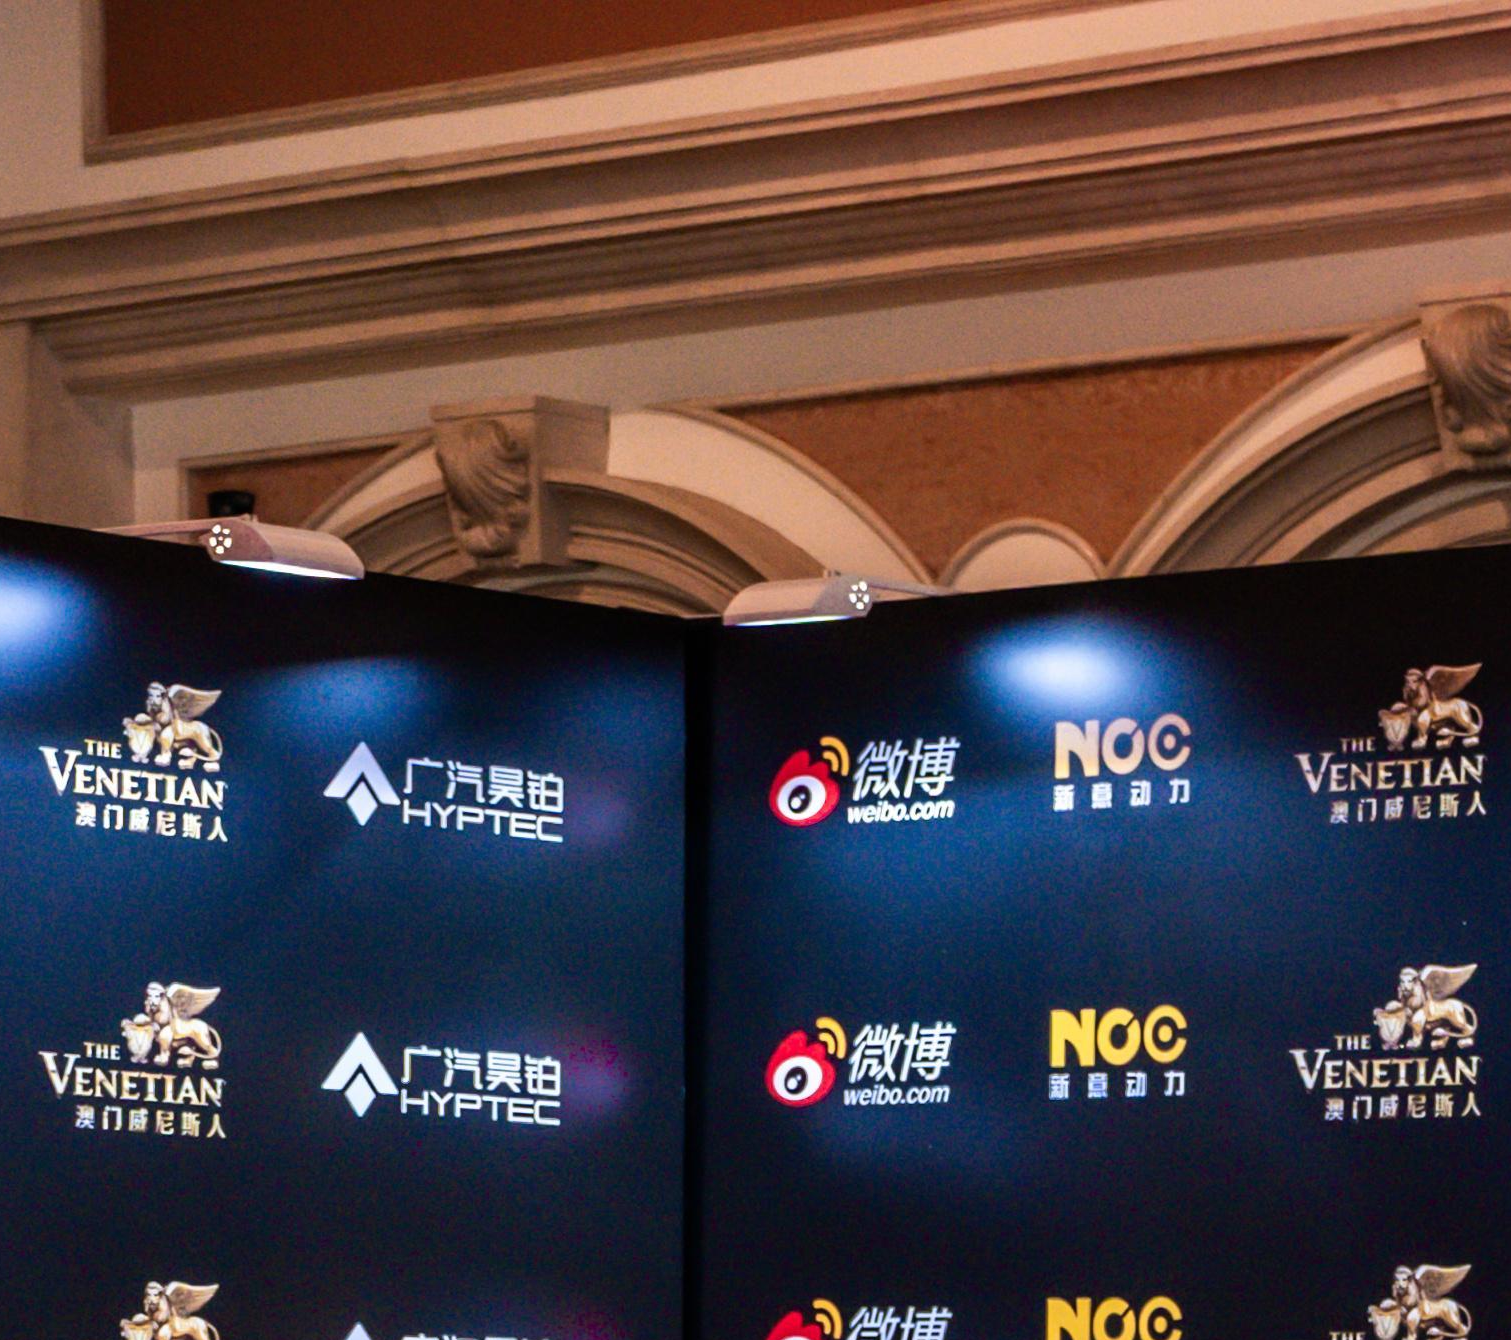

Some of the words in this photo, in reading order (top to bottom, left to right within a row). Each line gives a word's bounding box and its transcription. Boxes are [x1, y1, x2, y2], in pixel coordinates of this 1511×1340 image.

[85, 739, 122, 759] THE
[1055, 715, 1190, 778] NOC
[39, 741, 228, 810] VENETIAN
[403, 757, 563, 813] 广汽昊铂
[853, 737, 960, 801] 微博
[1296, 753, 1484, 792] VENETIAN
[848, 800, 955, 824] weibo.com
[1054, 778, 1190, 812] 新意动力
[76, 802, 227, 842] 澳门威尼斯人
[403, 799, 563, 842] HYPTEC
[849, 1021, 956, 1083] 微博
[1051, 1005, 1187, 1067] NOC
[39, 1046, 226, 1107] VENETIAN
[401, 1045, 561, 1096] 广汽昊铂
[1289, 1045, 1479, 1089] VENETIAN
[401, 1089, 560, 1126] HYPTEC
[844, 1084, 950, 1105] weibo.com
[1325, 1092, 1480, 1120] 澳门威尼斯人
